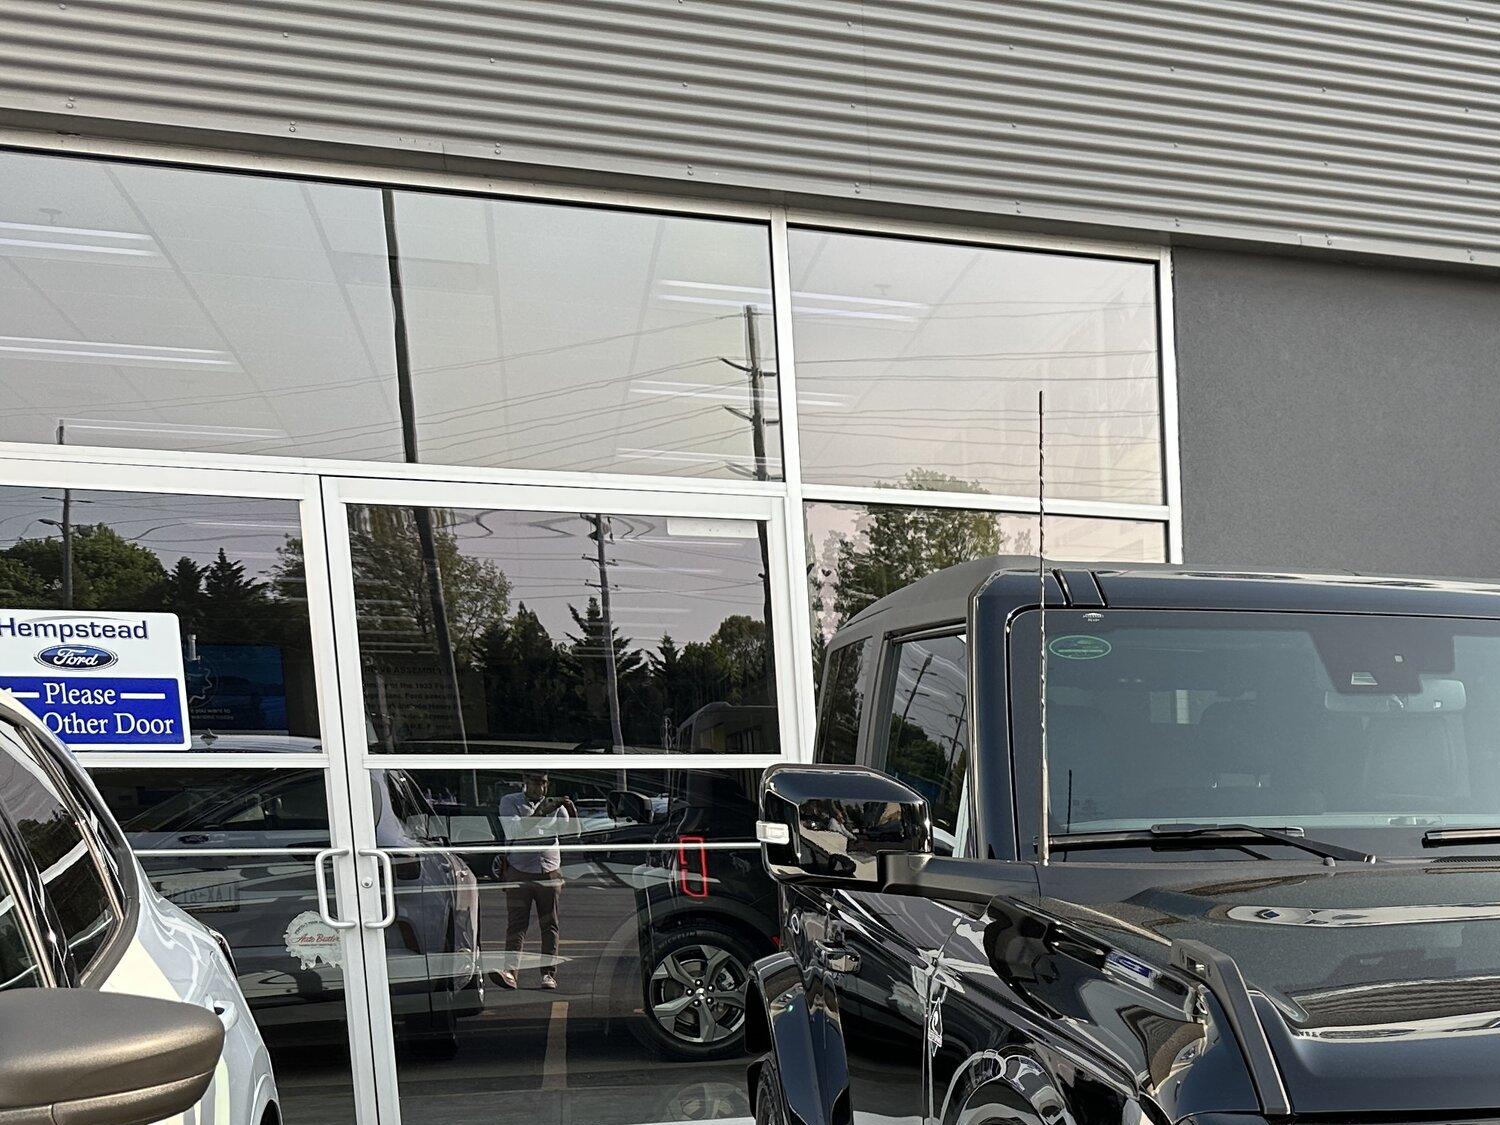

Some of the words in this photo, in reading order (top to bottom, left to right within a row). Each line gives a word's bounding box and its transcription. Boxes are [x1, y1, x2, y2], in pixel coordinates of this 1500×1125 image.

[0, 617, 149, 642] Hempstead
[43, 682, 116, 705] Please
[42, 712, 109, 735] Other
[114, 712, 174, 735] Door
